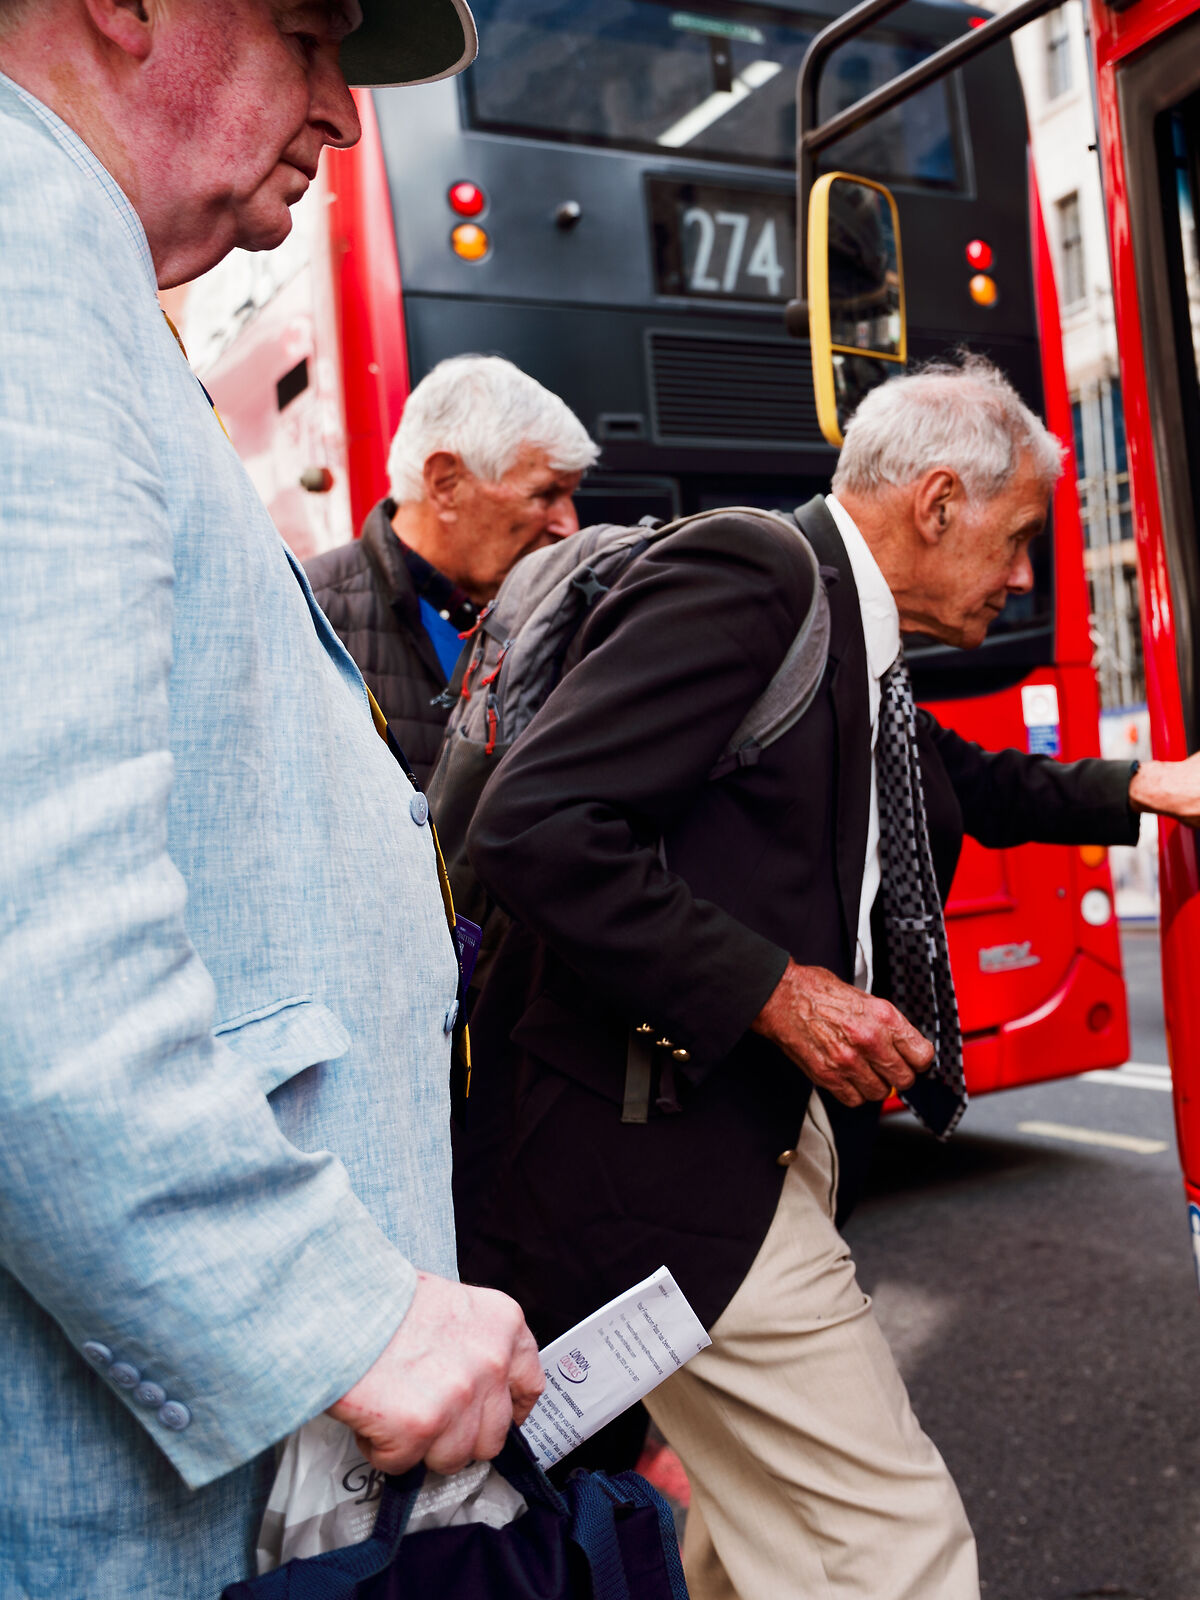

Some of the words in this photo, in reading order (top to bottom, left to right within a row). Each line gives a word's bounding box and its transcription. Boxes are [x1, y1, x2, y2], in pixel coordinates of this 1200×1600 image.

[683, 207, 785, 296] 274
[640, 1308, 655, 1326] Freedom
[651, 1323, 661, 1334] Pass
[559, 1354, 581, 1379] COUNCILS
[568, 1346, 591, 1372] LONDON
[542, 1367, 553, 1378] Card
[545, 1398, 560, 1415] applying
[568, 1424, 582, 1440] Freedom
[539, 1428, 555, 1445] Freedom
